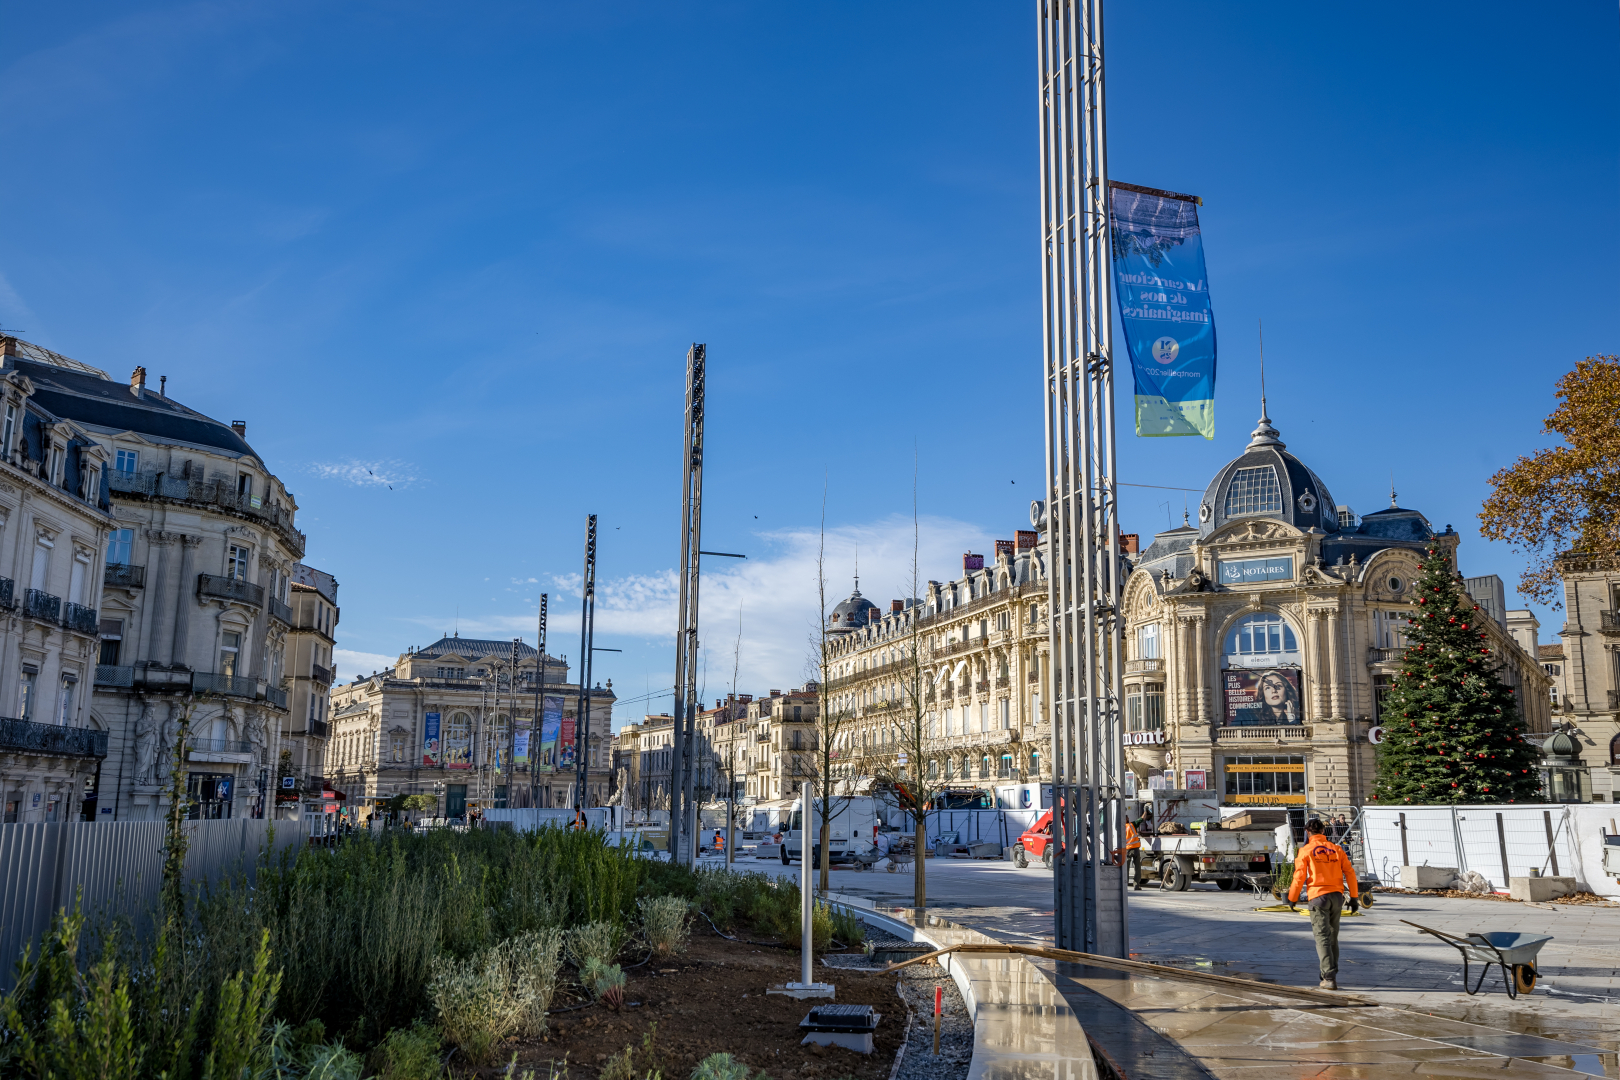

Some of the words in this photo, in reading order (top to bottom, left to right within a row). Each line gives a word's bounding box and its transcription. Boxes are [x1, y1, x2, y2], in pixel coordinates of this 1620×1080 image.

[1241, 566, 1285, 577] NOTAIRES
[1228, 695, 1254, 703] HISTOIRES
[1228, 702, 1263, 710] COMMENCENT
